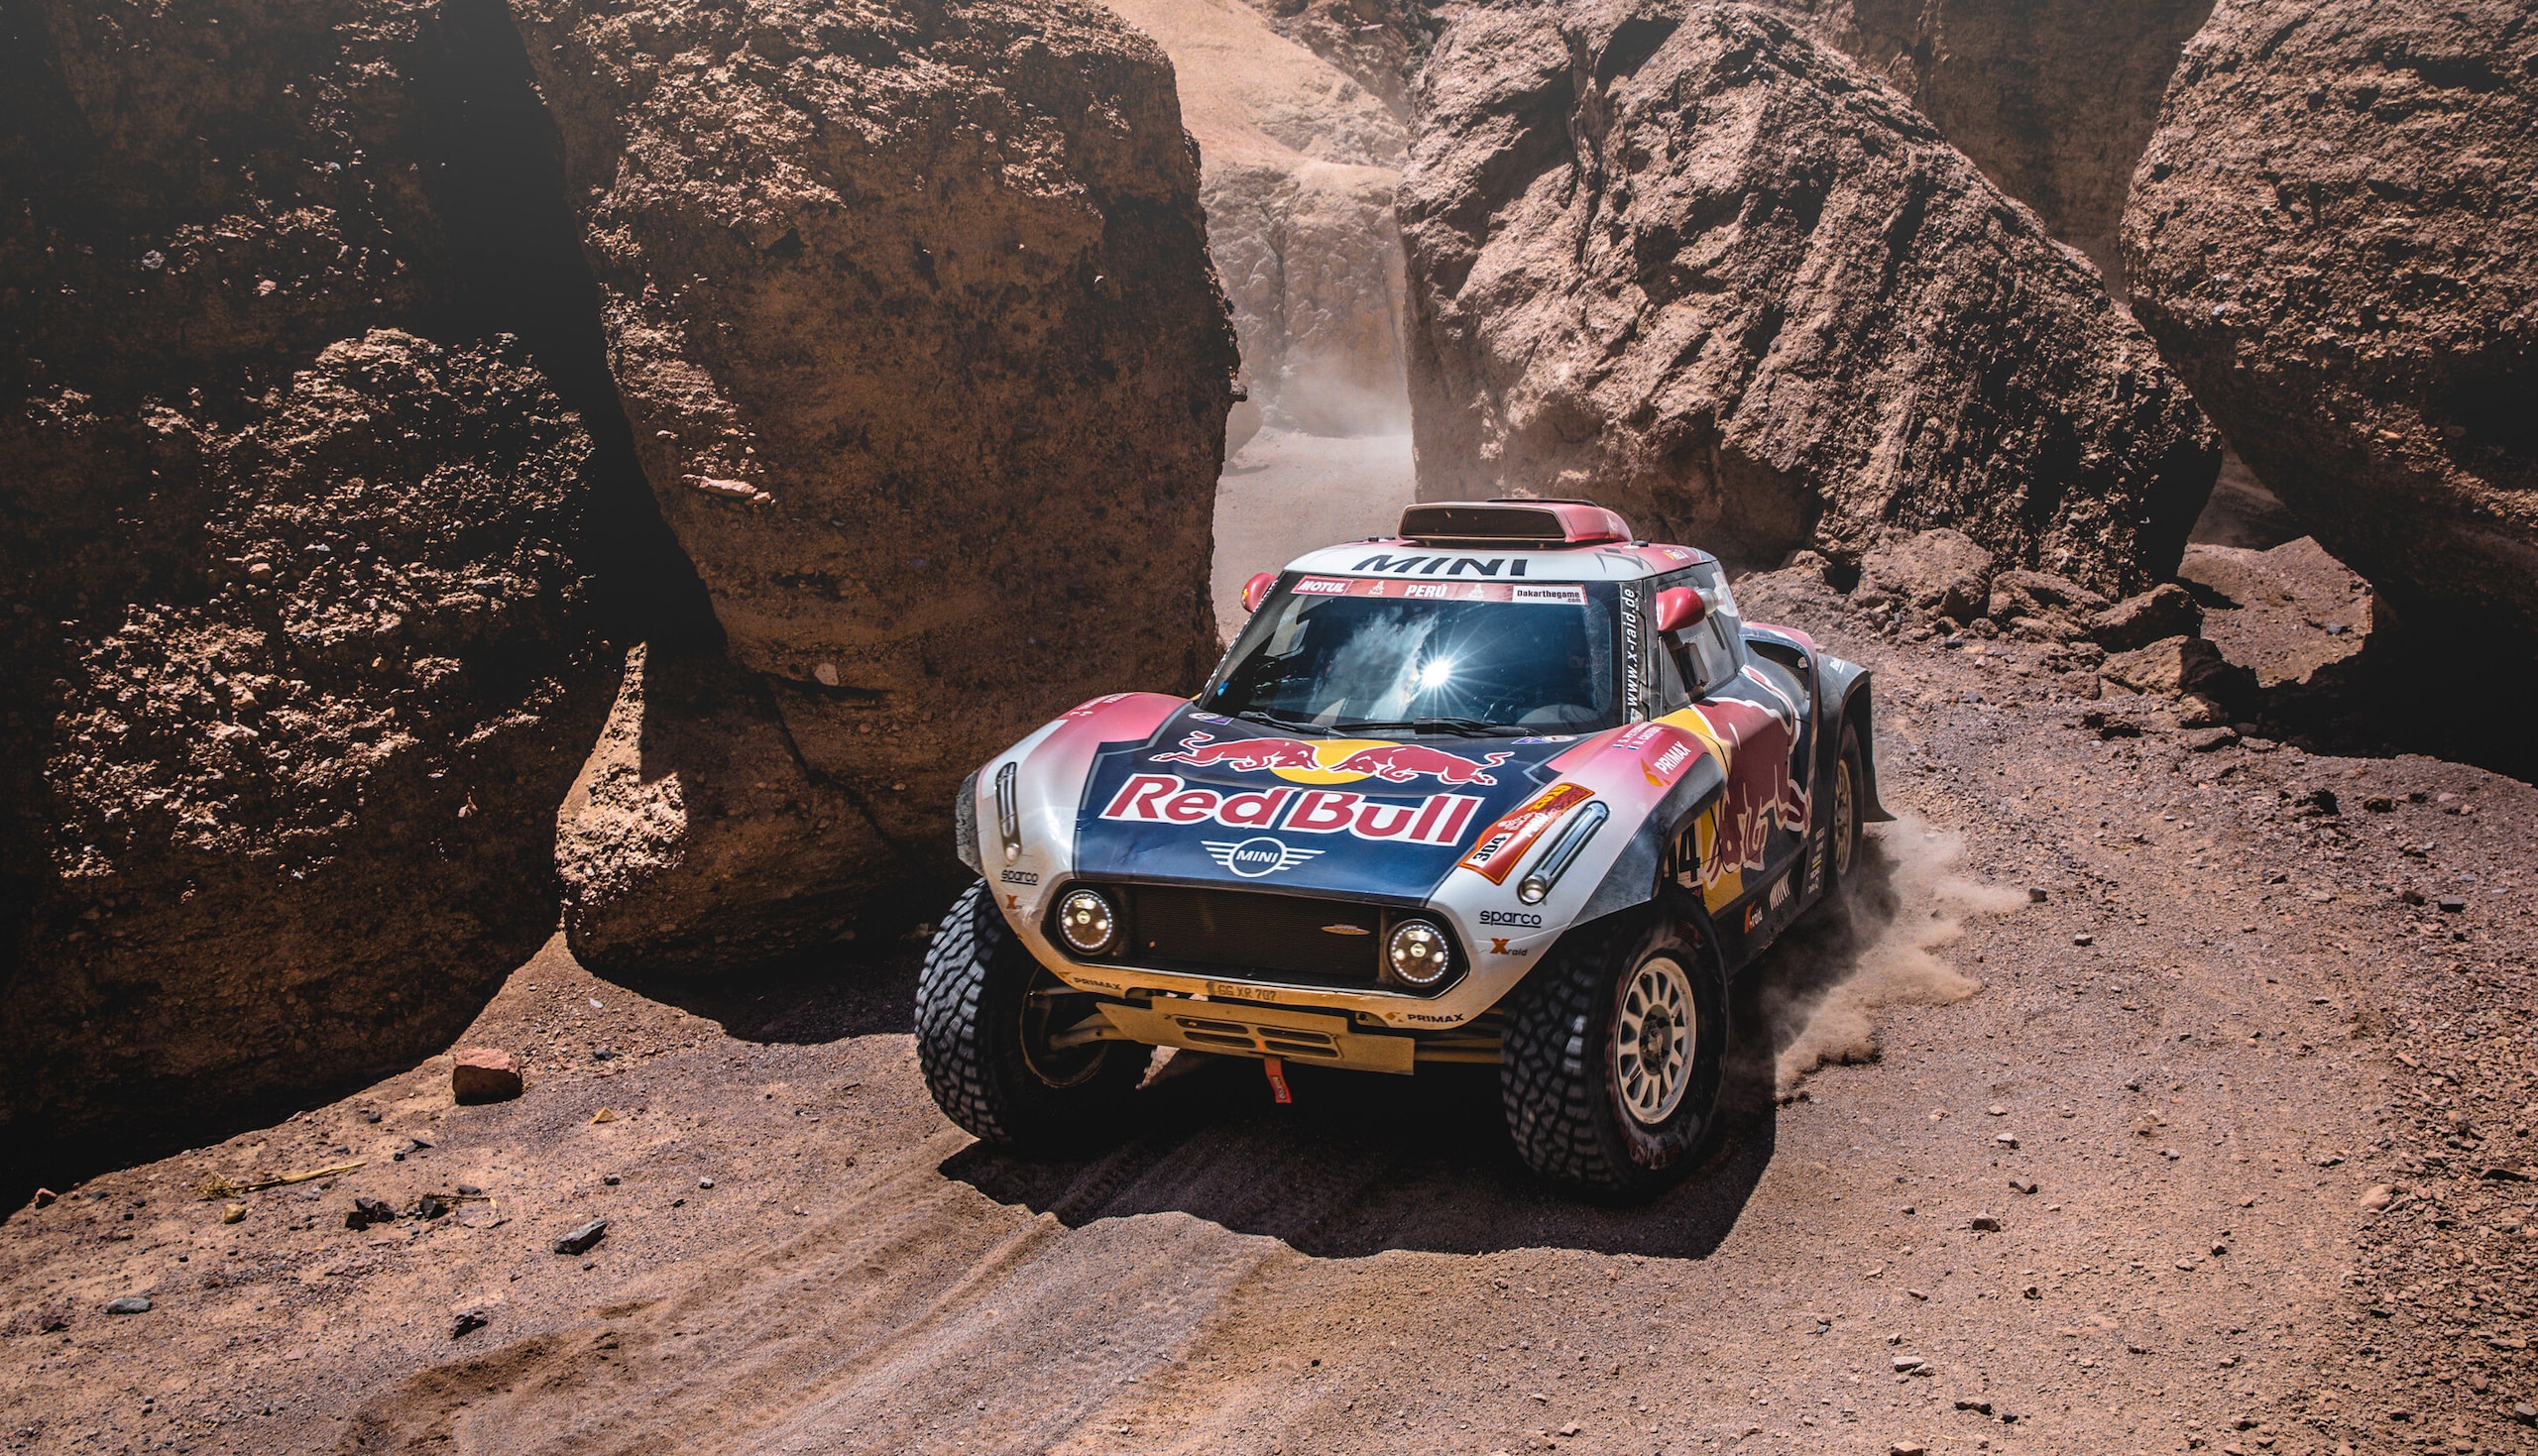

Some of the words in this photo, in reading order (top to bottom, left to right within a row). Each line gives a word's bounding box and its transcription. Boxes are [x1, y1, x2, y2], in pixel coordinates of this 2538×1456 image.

[1350, 554, 1528, 577] MINI
[1297, 580, 1346, 593] MOTUL
[1405, 583, 1447, 598] PERÚ
[1517, 590, 1580, 600] Dakarthegame
[1623, 588, 1639, 707] www.x-raid.de
[1653, 740, 1691, 775] PRIMAX
[1097, 773, 1300, 830] Red
[1279, 786, 1485, 846] Bull
[1234, 849, 1279, 864] MINI
[1472, 835, 1507, 862] 304
[1000, 869, 1039, 886] sparco
[1479, 910, 1542, 928] sparco
[1073, 976, 1122, 991] PRIMAX
[1236, 986, 1255, 999] XR
[1255, 989, 1277, 1002] 707
[1407, 1012, 1465, 1024] PRIMAX
